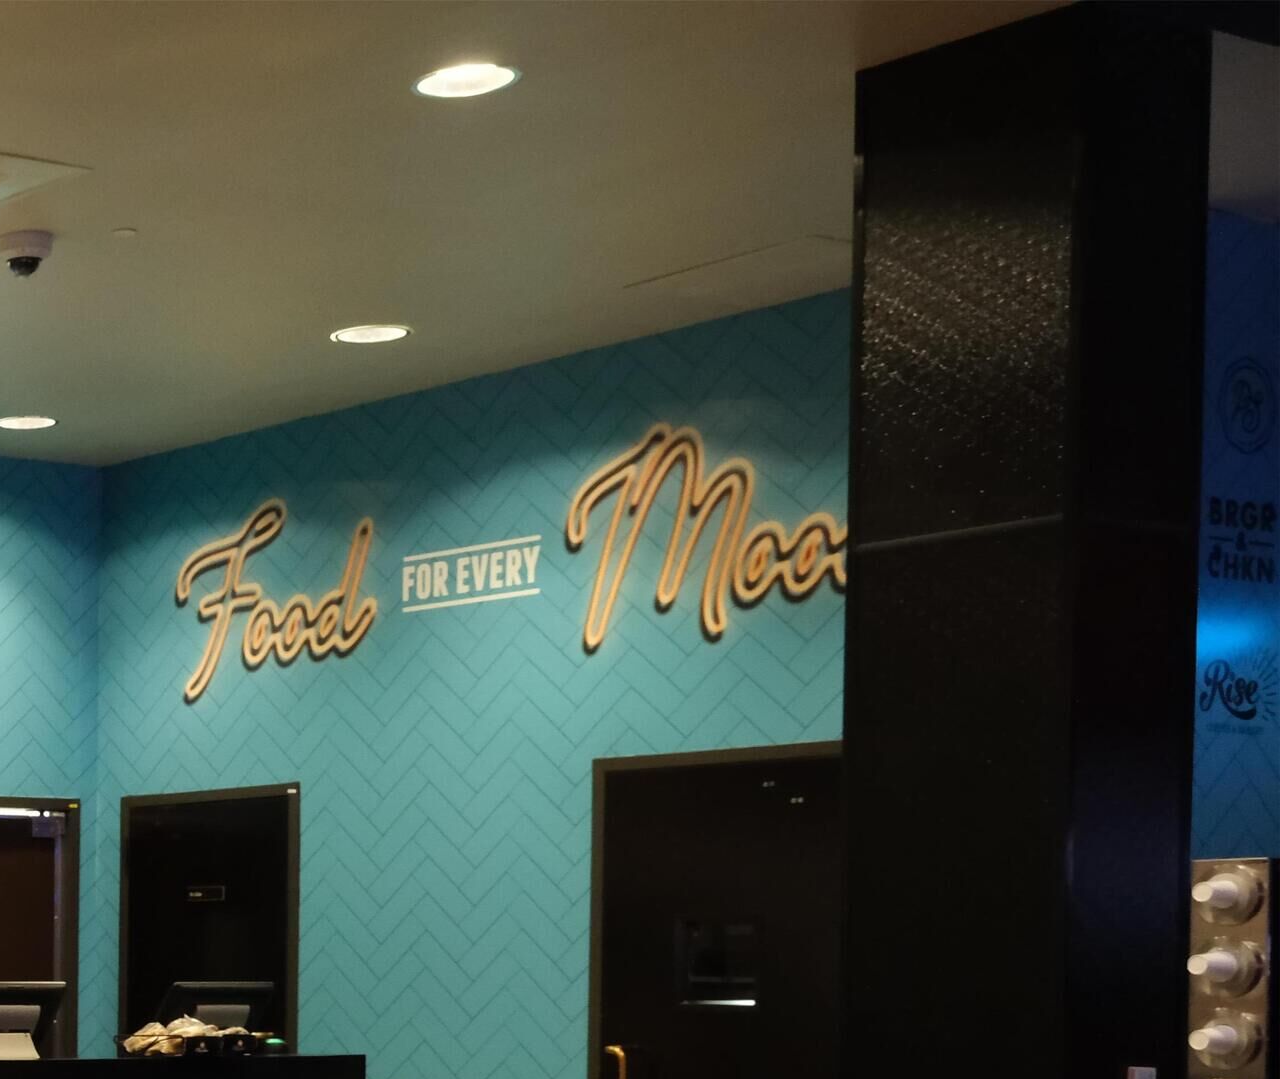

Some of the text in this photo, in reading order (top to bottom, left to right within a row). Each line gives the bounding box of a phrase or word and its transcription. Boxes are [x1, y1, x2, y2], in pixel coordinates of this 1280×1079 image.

[565, 421, 848, 655] Moo
[1208, 495, 1277, 533] BRGR
[402, 545, 541, 602] FOR EVERY
[1207, 546, 1275, 584] CHKN
[175, 498, 378, 704] Food
[1199, 659, 1261, 721] Rise
